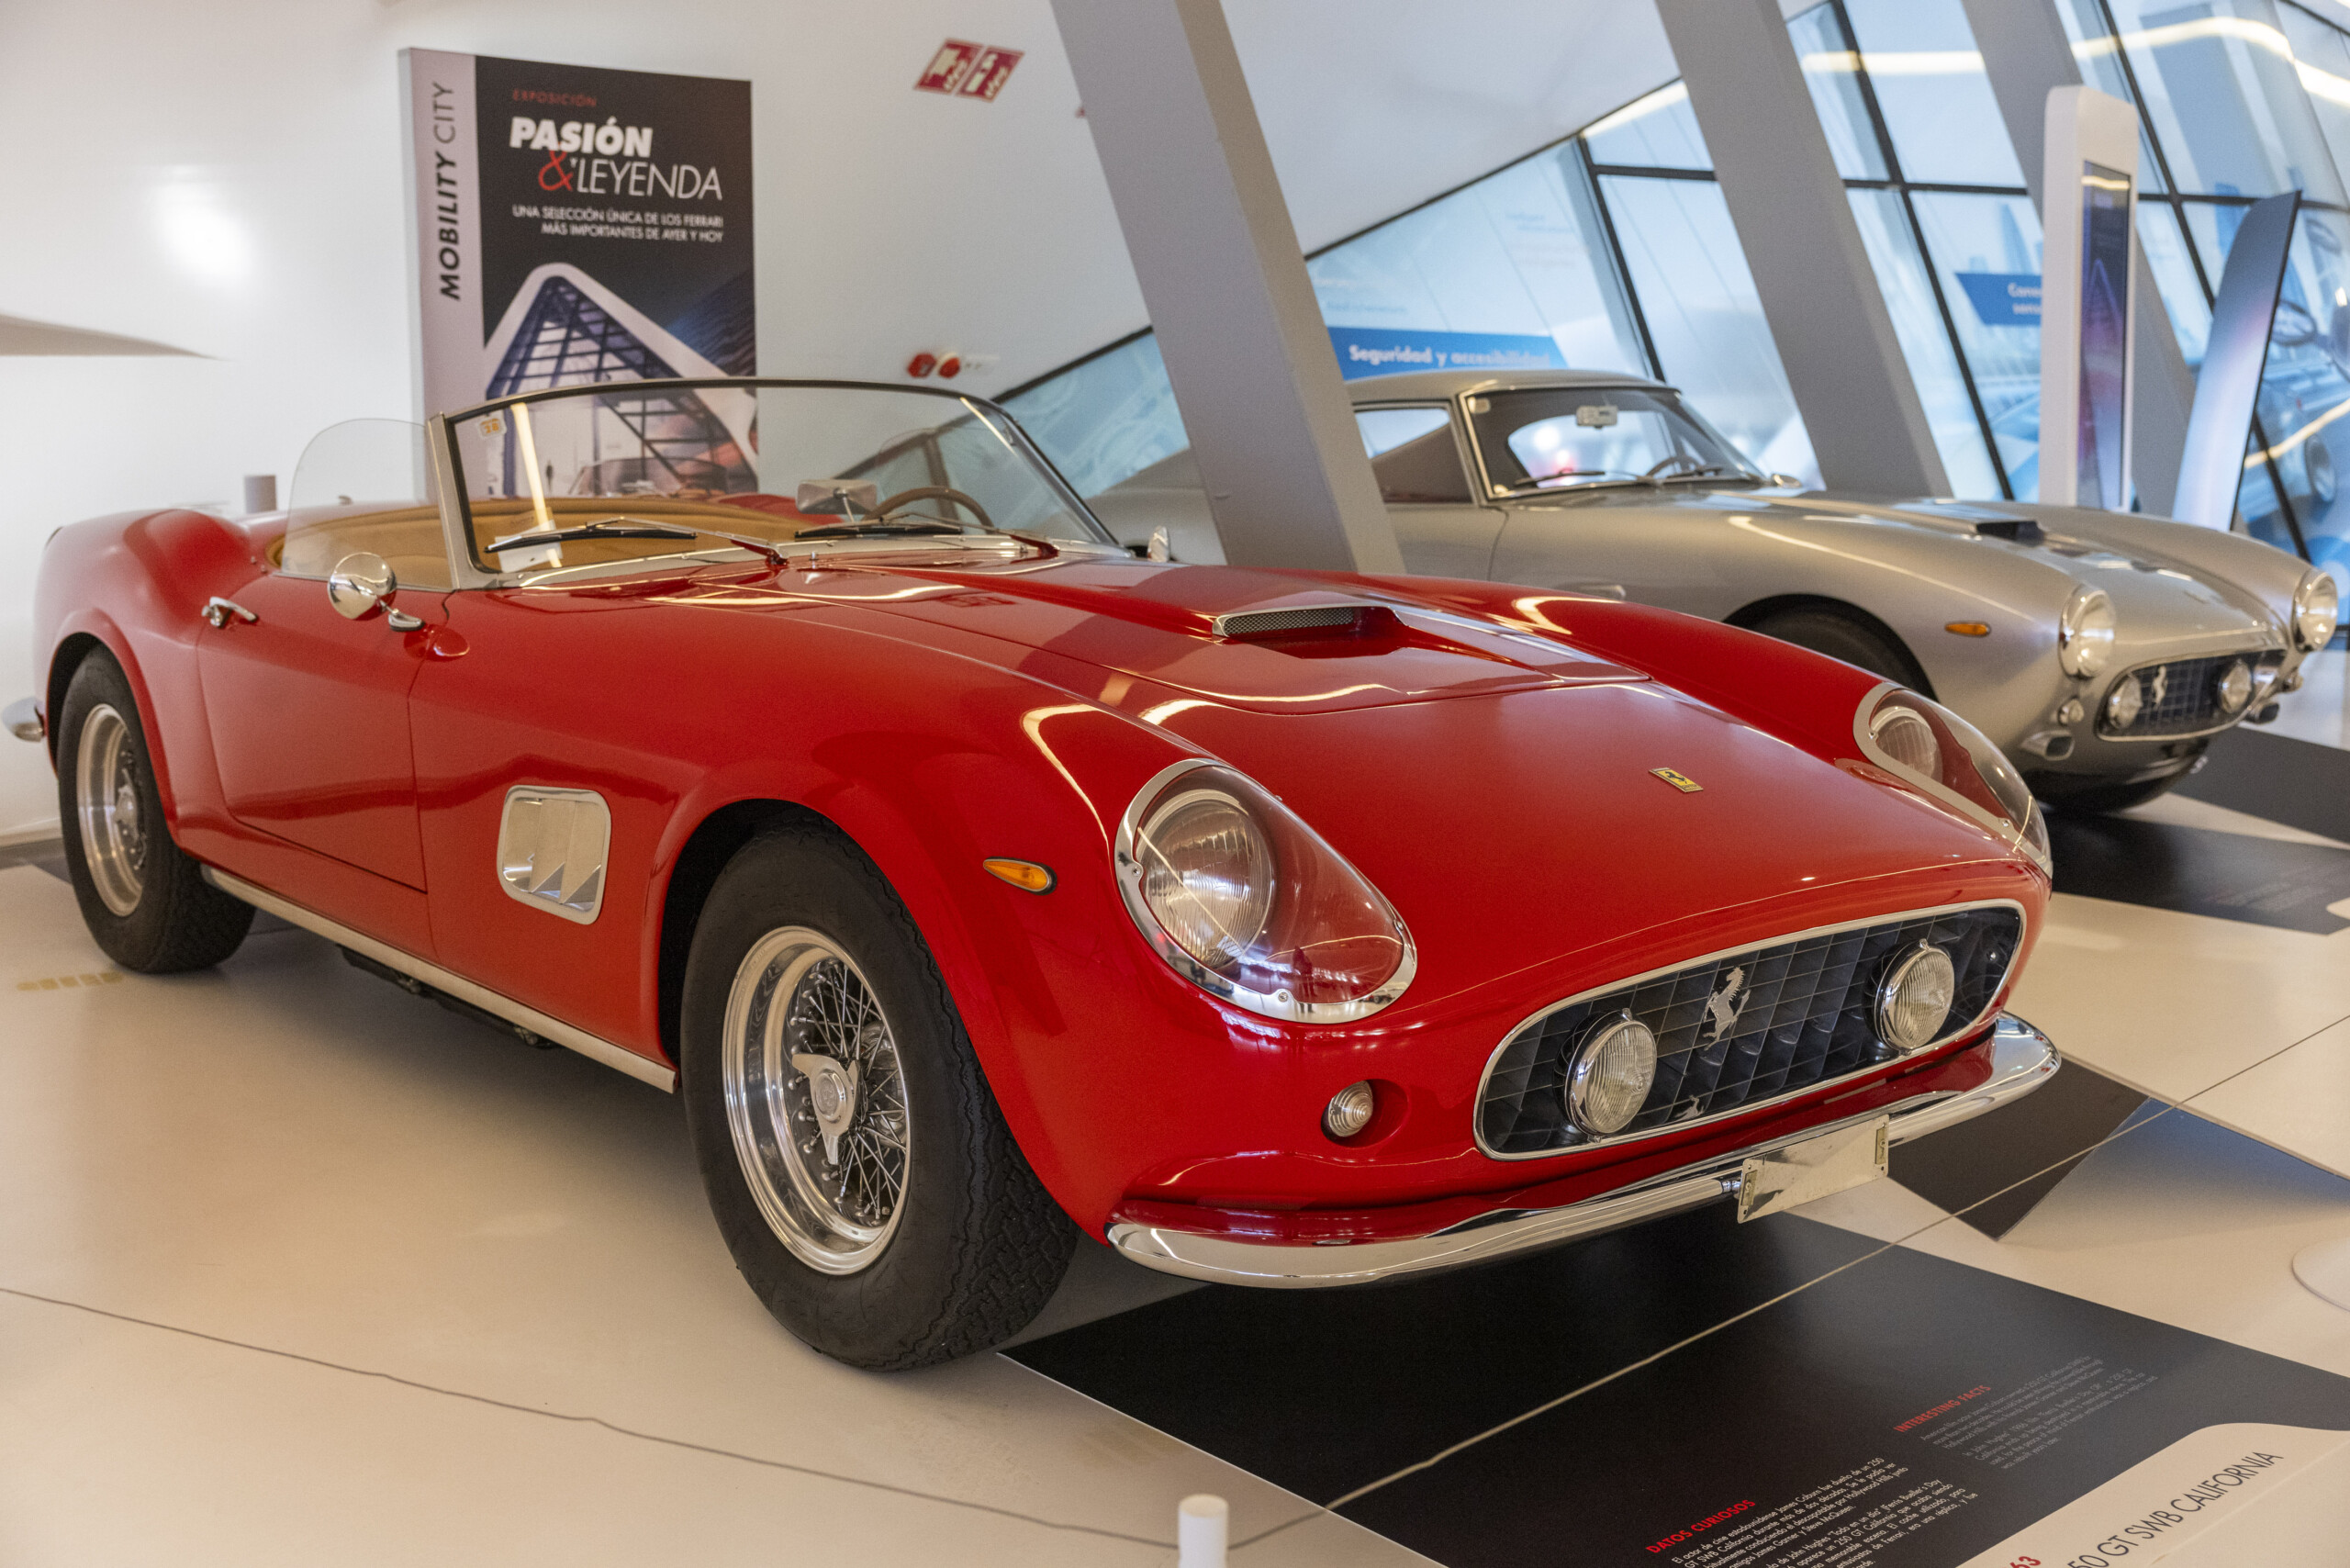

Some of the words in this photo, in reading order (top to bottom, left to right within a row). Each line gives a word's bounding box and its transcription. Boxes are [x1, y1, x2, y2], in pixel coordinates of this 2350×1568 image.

[432, 81, 456, 144] CITY
[512, 88, 597, 107] EXPOSICIÓN
[509, 116, 653, 158] PASIÓN
[576, 158, 722, 201] LEYENDA
[435, 150, 461, 301] MOBILITY
[512, 204, 541, 218] UNA
[542, 206, 605, 221] SELECCIÓN
[607, 207, 643, 224] ÚNICA
[644, 211, 659, 226] DE
[660, 212, 682, 227] LOS
[683, 214, 724, 229] FERRARI
[541, 220, 568, 236] MÁS
[569, 223, 643, 240] IMPORTANTES
[644, 227, 660, 241] DE
[661, 228, 688, 241] AYER
[689, 230, 698, 241] Y
[699, 230, 723, 242] HOY
[1348, 344, 1432, 365] Seguridad
[1436, 353, 1448, 367] y
[1893, 1400, 1962, 1433] INTERESTING
[1957, 1384, 1992, 1402] FACTS
[2097, 1535, 2139, 1556] GT
[2124, 1510, 2185, 1540] SWB
[2170, 1451, 2285, 1513] CALIFORNIA
[1645, 1529, 1694, 1553] DATOS
[1690, 1499, 1756, 1532] CURIOSOS
[1851, 1529, 1864, 1537] GT
[1684, 1560, 1699, 1568] GT
